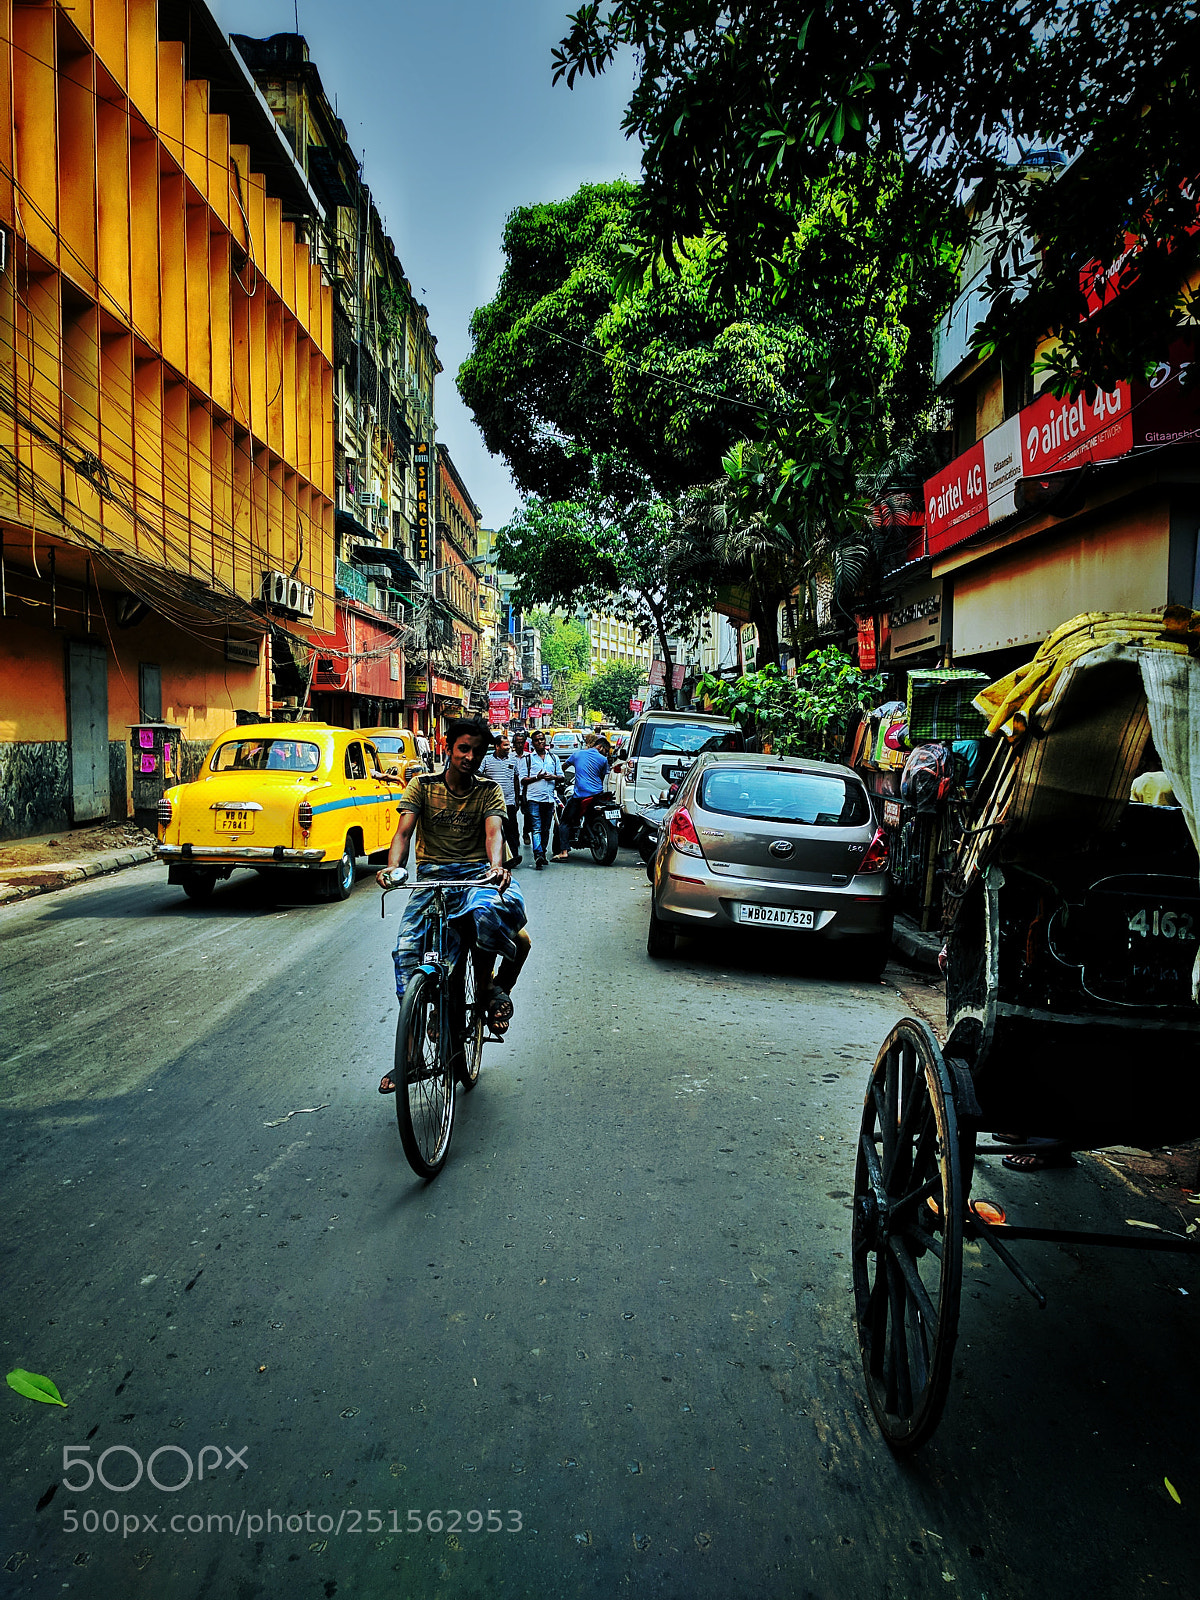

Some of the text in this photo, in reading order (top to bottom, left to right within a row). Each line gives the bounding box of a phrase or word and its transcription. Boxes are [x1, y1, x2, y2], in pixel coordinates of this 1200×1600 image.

[1042, 386, 1121, 454] airtel 4G
[415, 455, 429, 463] HOTEL
[993, 452, 1013, 473] Gitaanshi
[987, 465, 1021, 491] Communications
[937, 464, 983, 519] airtel 4G
[418, 466, 428, 559] STAR CITY
[463, 634, 472, 666] PRINCE
[222, 821, 247, 830] F7841
[226, 811, 247, 820] WB 04
[748, 907, 812, 925] WB02AD7529
[1128, 908, 1196, 940] 4162
